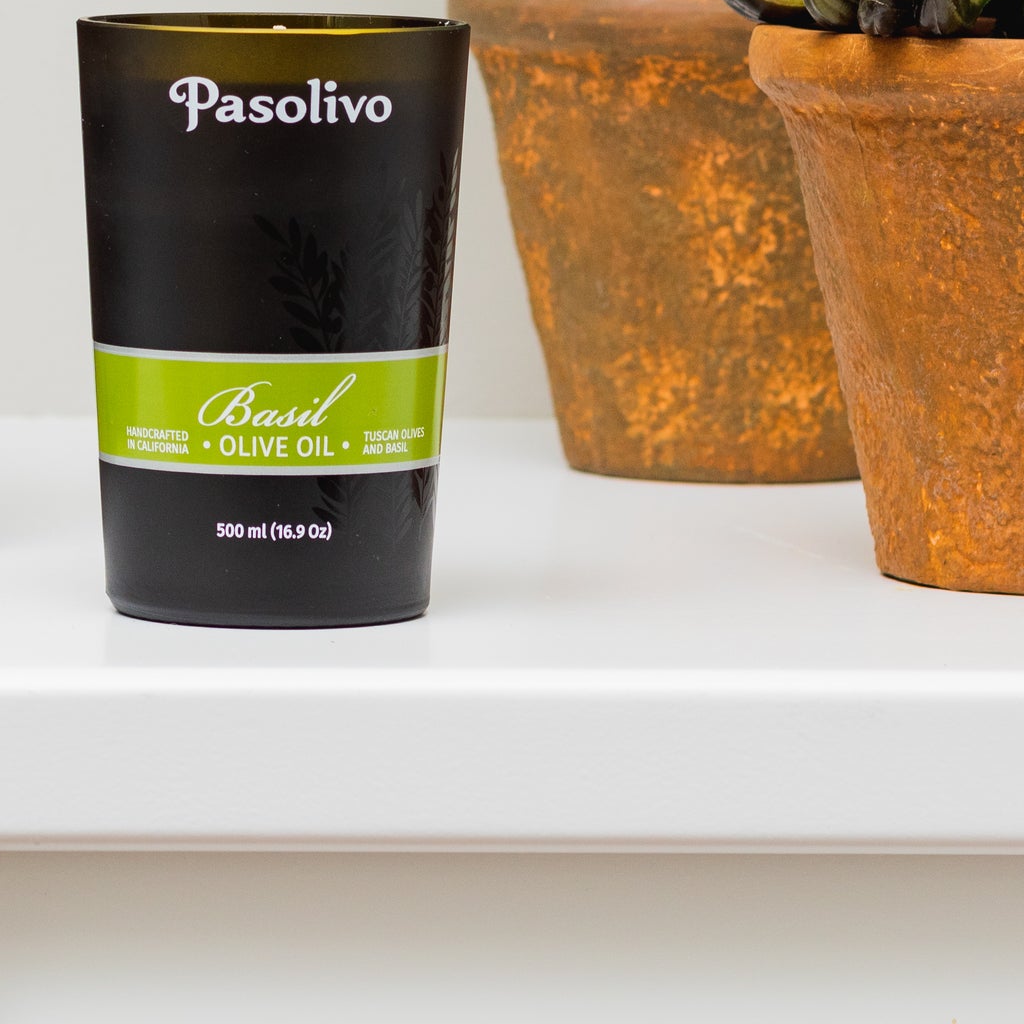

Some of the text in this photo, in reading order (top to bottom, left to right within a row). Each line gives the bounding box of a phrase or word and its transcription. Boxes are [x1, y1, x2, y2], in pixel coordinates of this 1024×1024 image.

[169, 76, 393, 132] Pasolivo
[197, 373, 357, 428] Basil
[126, 426, 189, 442] HANDCRAFTED
[363, 426, 425, 442] TUSCAN OLIVES
[127, 439, 189, 455] IN CALIFORNIA
[219, 435, 334, 458] OLIVE OIL
[362, 441, 408, 455] AND BASIL
[216, 521, 332, 541] 500 ml (16.9 Oz)
